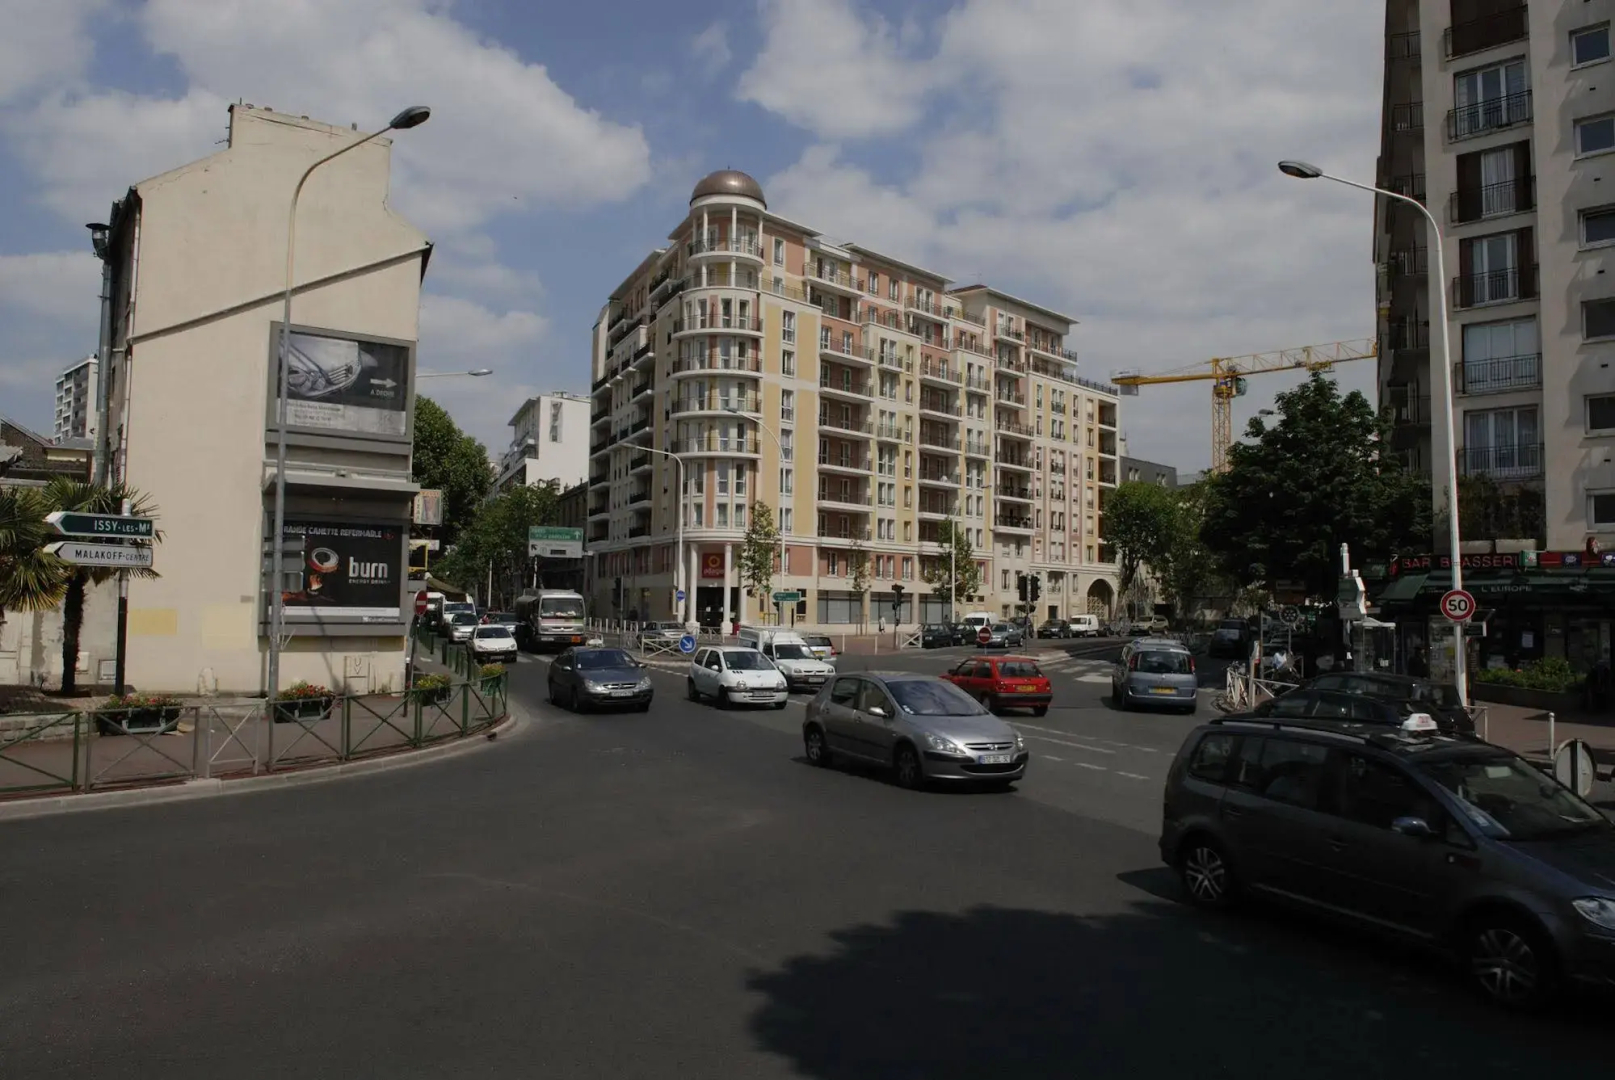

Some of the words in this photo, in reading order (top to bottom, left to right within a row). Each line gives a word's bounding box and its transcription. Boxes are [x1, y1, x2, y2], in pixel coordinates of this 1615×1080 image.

[349, 556, 388, 579] burn
[1402, 557, 1431, 569] BAR
[1440, 555, 1518, 569] BASSERI
[1448, 600, 1468, 612] 50
